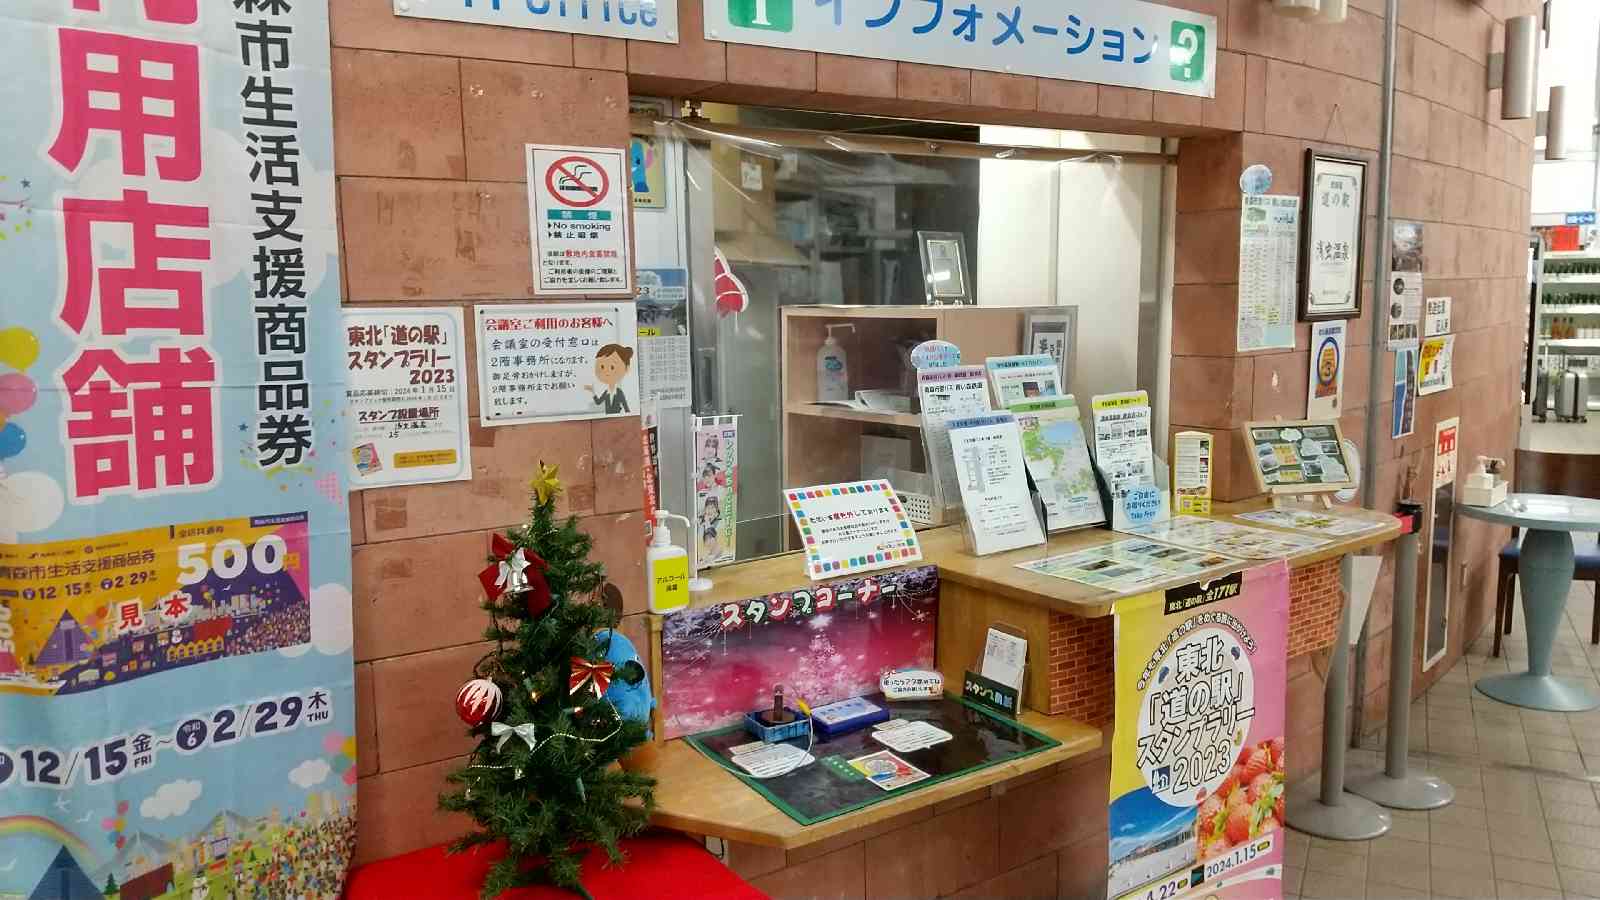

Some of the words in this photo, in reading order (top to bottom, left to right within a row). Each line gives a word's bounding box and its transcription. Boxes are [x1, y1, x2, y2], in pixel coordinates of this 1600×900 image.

[553, 222, 567, 230] No
[570, 222, 611, 232] smoking
[47, 0, 216, 498] 用店舗
[347, 325, 447, 347] 東北「道の駅」
[485, 316, 614, 331] 会議室ご利用のお客様へ
[347, 349, 451, 370] スタンプラリー
[492, 336, 600, 350] 会議室の受付窓口は
[409, 368, 455, 385] 2023
[176, 534, 288, 586] 500
[720, 576, 897, 630] スタンプコーナー
[1175, 634, 1225, 684] 東北
[1149, 669, 1244, 727] 「道の駅」
[306, 710, 330, 722] THU
[20, 739, 127, 786] 12/15
[132, 733, 152, 756] 金
[212, 696, 303, 743] 2/29
[307, 690, 328, 709] 木
[1136, 703, 1256, 769] スタンプラリー
[133, 754, 152, 769] FRI
[1172, 739, 1231, 794] 2023
[1207, 843, 1256, 878] 2024.1.15
